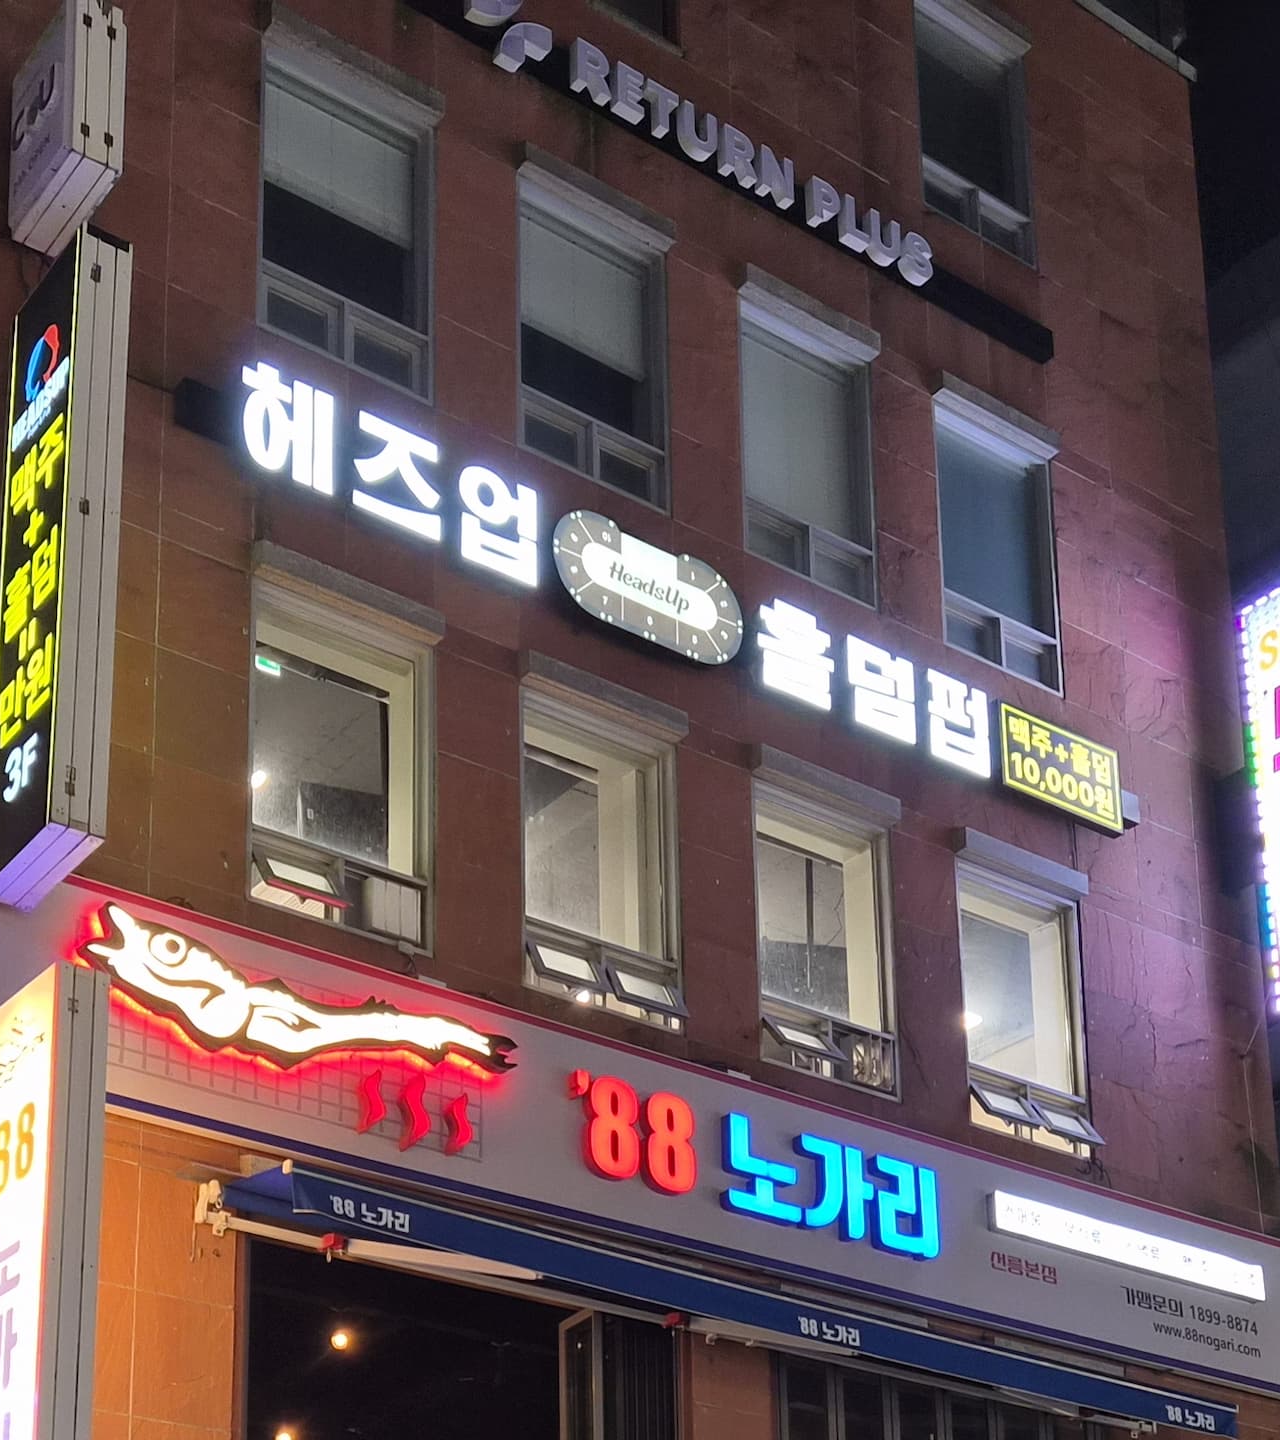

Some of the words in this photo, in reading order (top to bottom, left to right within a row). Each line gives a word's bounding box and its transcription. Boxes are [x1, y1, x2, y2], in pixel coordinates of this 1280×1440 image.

[570, 37, 794, 210] RETURN
[806, 175, 934, 287] PLUS
[10, 412, 64, 514] 맥주
[241, 361, 537, 588] 헤즈업
[4, 524, 59, 641] 홀덤
[608, 561, 690, 614] HeadsUp
[0, 632, 53, 748] 만원
[758, 599, 991, 778] 홀덤펍
[3, 734, 38, 803] 3F
[1011, 752, 1114, 817] 10,000원
[567, 1069, 698, 1196] '88
[720, 1112, 941, 1260] 노가리
[360, 1202, 410, 1233] 노가리
[822, 1321, 861, 1347] 노가리
[1120, 1285, 1184, 1319] 가맹문의
[1189, 1304, 1259, 1336] 1899-8874
[1153, 1320, 1262, 1359] www.88nogari.com
[1184, 1409, 1215, 1432] 노가리
